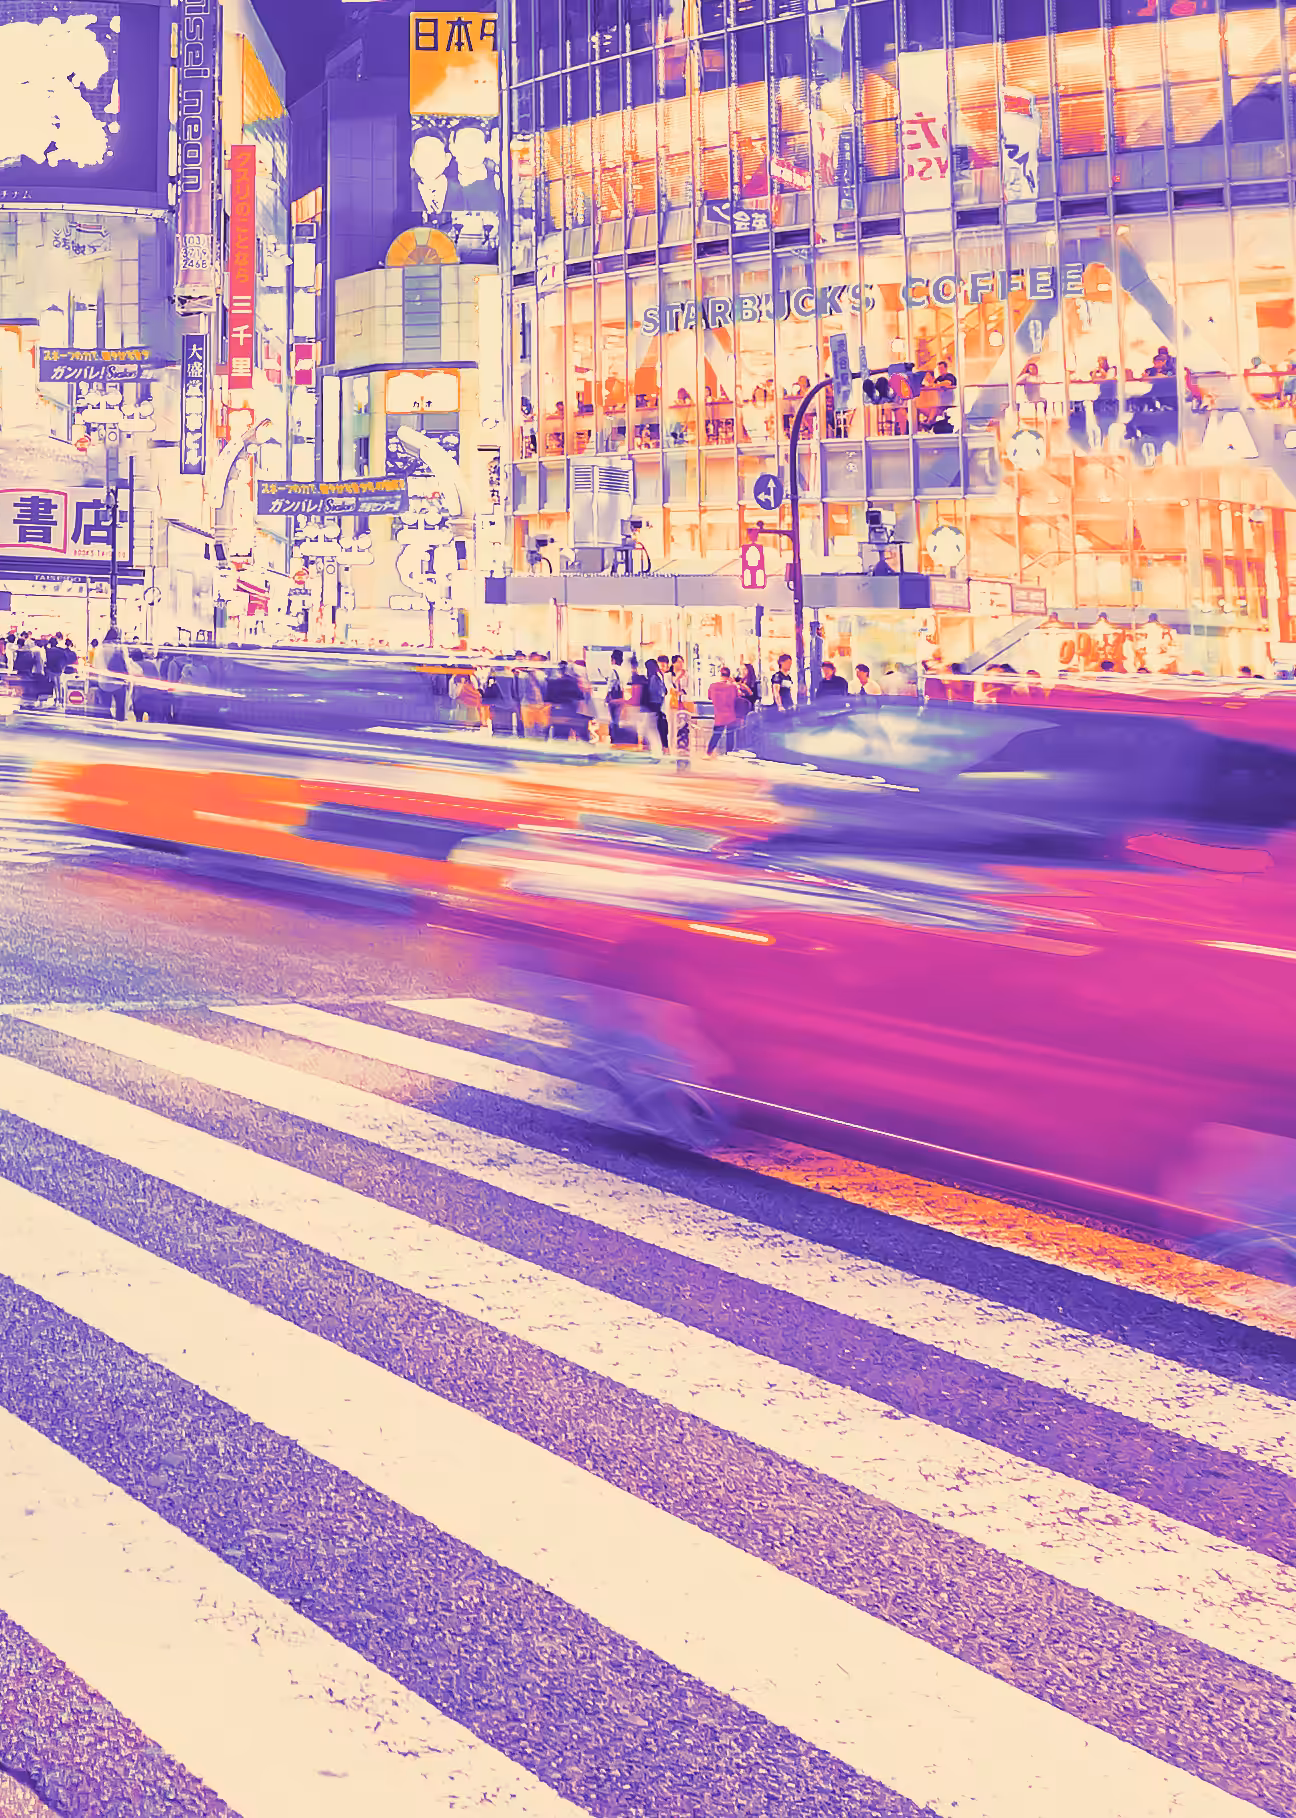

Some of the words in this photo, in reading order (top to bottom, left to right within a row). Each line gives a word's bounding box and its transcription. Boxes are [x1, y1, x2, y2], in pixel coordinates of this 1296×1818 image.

[182, 89, 203, 193] neon
[230, 295, 253, 377] 三千里
[641, 283, 876, 337] STARBUCKS
[901, 262, 1085, 310] COFFEE
[50, 365, 106, 379] ガンバレ!
[268, 498, 324, 512] ガンバレ!
